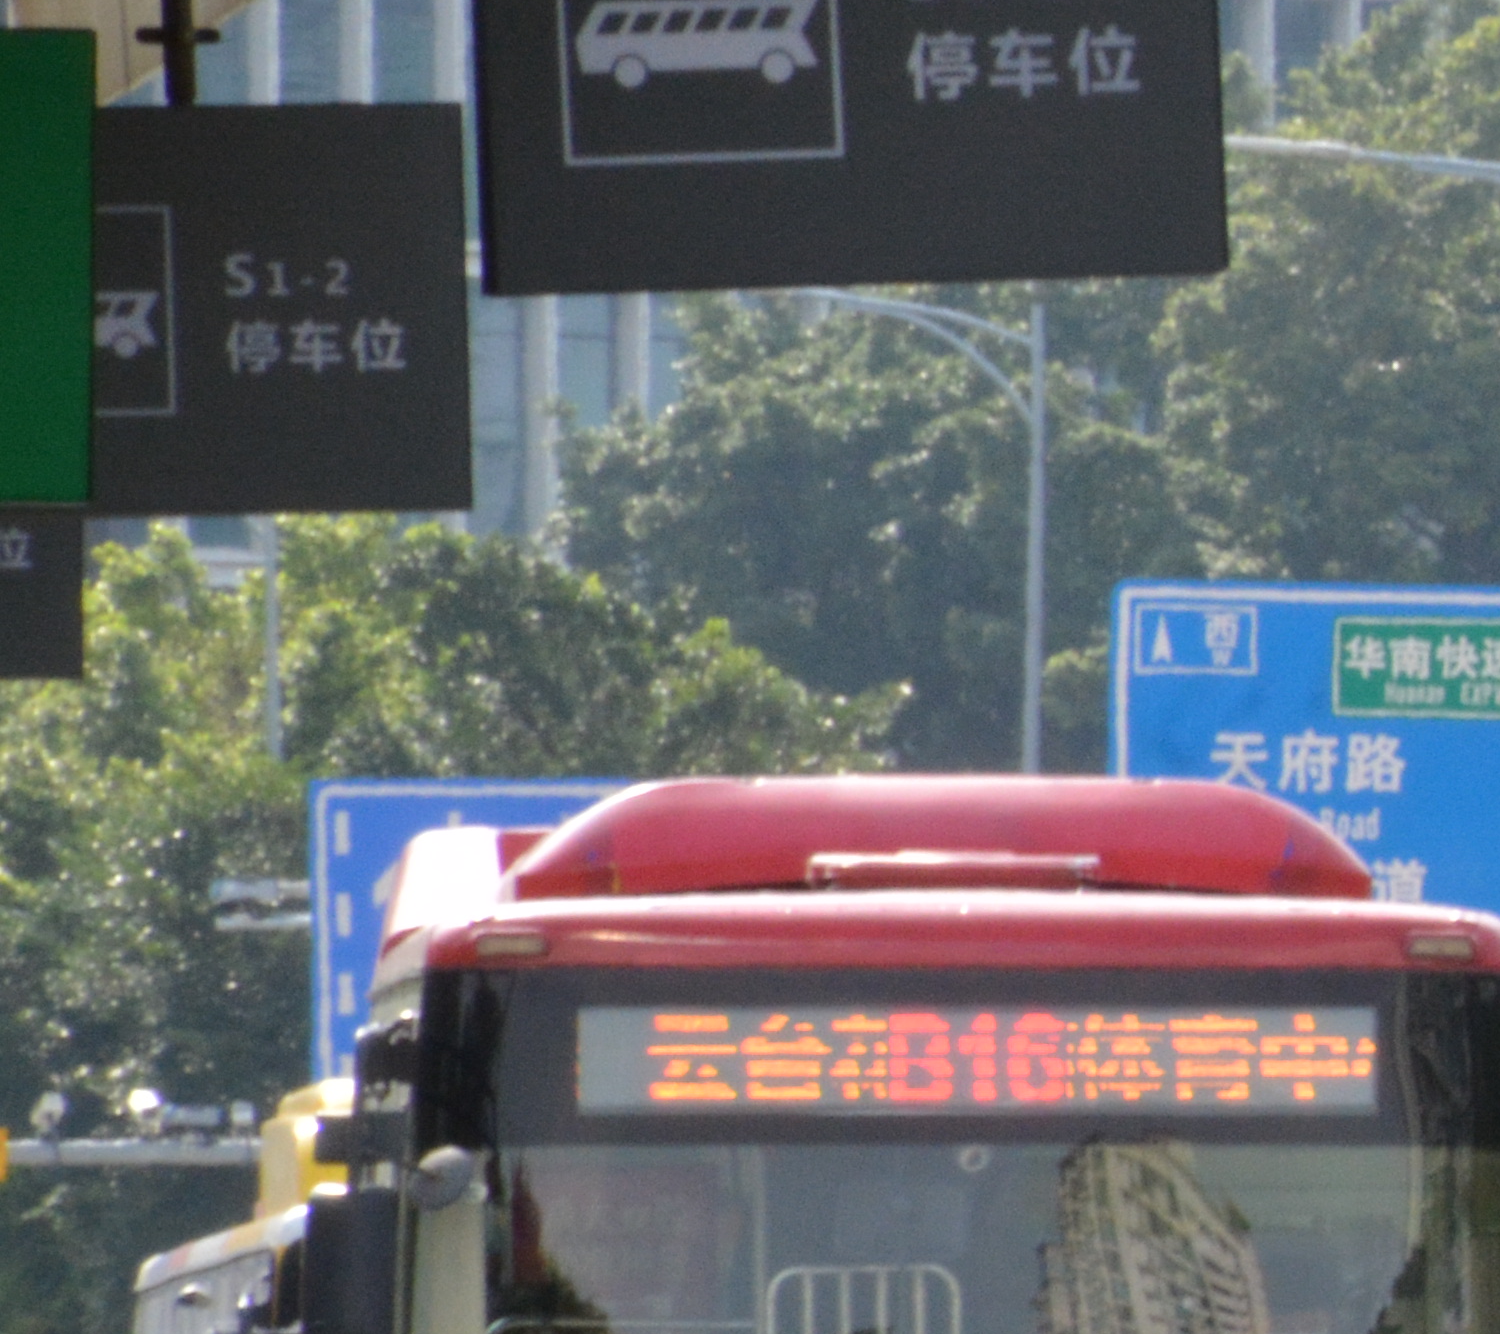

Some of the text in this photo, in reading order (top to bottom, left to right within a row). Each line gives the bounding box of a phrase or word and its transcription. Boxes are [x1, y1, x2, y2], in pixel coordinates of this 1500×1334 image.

[906, 22, 1142, 101] 停车位
[224, 252, 351, 299] S1-2
[226, 317, 408, 373] 停车位
[1208, 728, 1406, 794] 天府路
[888, 1011, 1066, 1104] B16
[1068, 1012, 1378, 1103] 体育中
